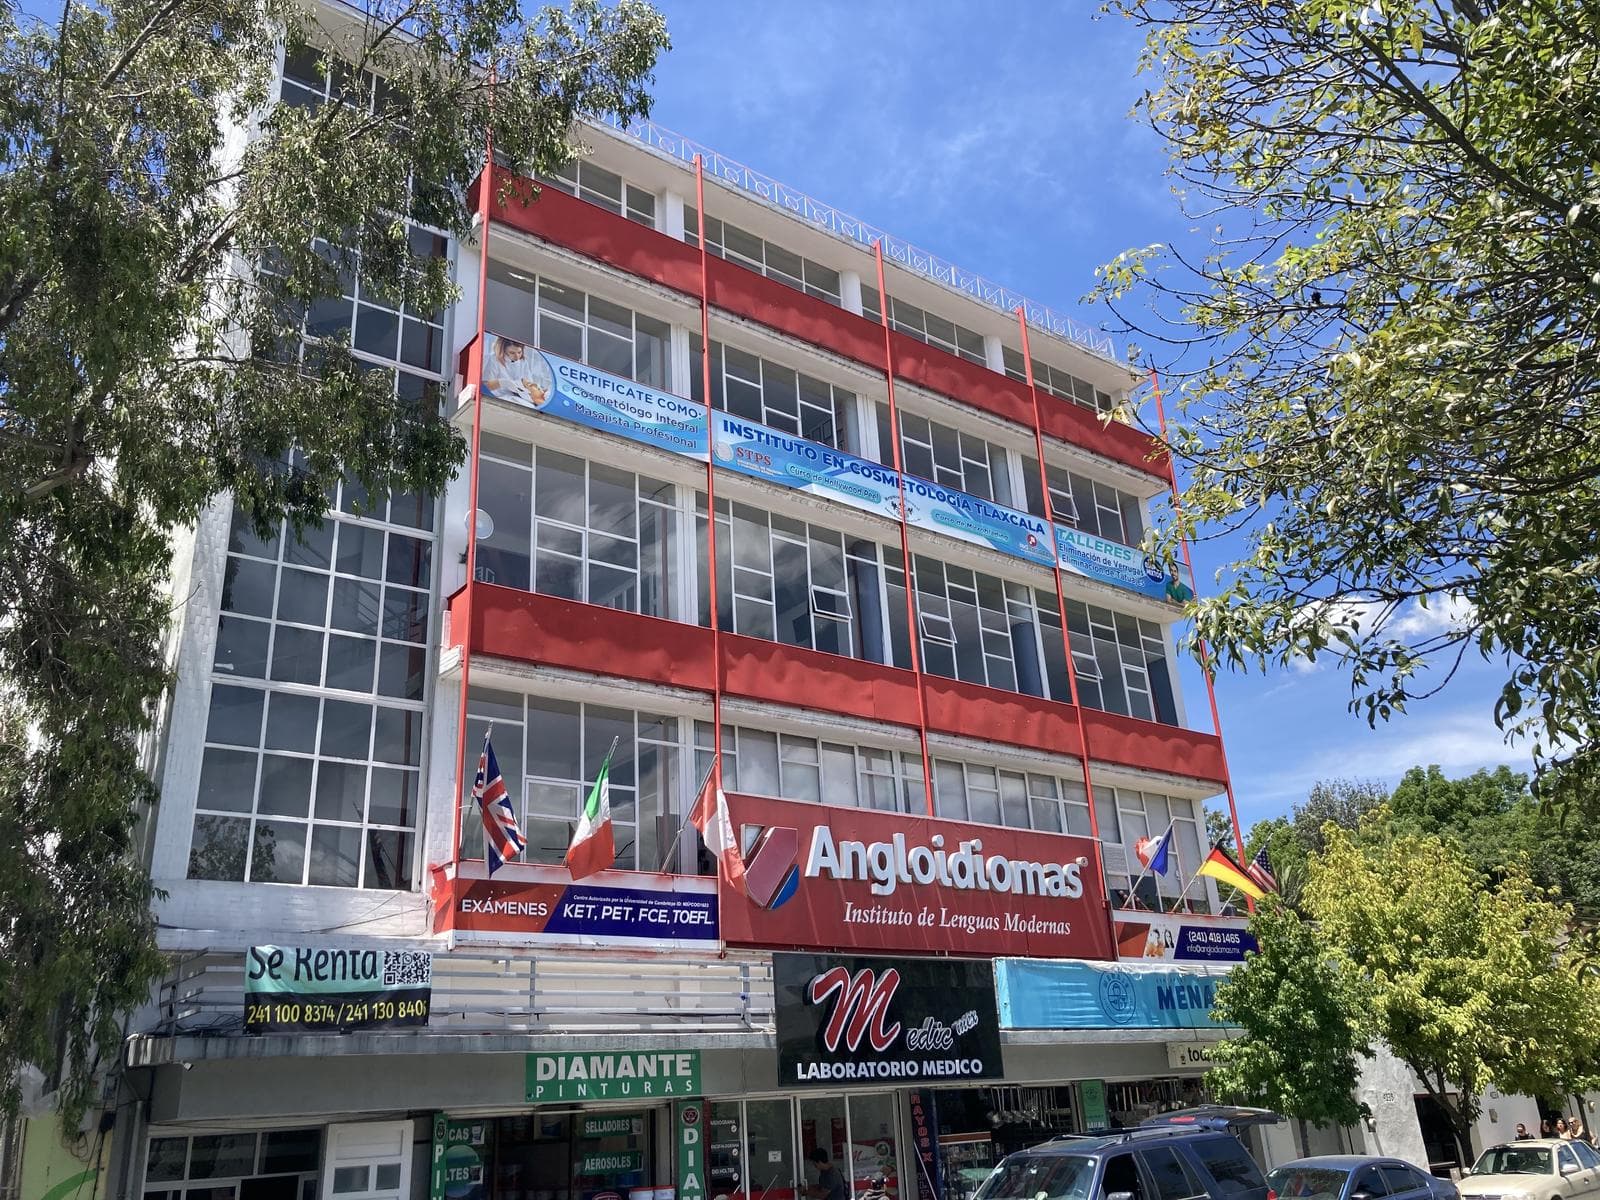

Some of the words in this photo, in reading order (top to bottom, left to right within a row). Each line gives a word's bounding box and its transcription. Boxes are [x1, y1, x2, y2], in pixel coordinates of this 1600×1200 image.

[559, 365, 653, 404] CERTIFICATE
[658, 398, 702, 420] COMO:
[572, 386, 652, 420] Cosmetólogo
[656, 411, 699, 433] Integral
[576, 403, 630, 429] Masajista
[634, 421, 697, 449] Profesional
[736, 446, 771, 466] STPS
[723, 419, 818, 460] INSTITUTO
[823, 455, 845, 470] EN
[850, 461, 971, 512] COSMETOLOGÍA
[974, 503, 1046, 535] TLAXCALA
[790, 465, 811, 479] Curso
[1056, 528, 1132, 561] TALLERES
[1059, 543, 1102, 563] Eliminación
[1103, 557, 1112, 567] de
[1062, 553, 1103, 575] Eliminación
[1106, 567, 1115, 577] de
[805, 825, 1084, 899] Angloidiomas
[461, 897, 548, 917] EXÁMENES
[563, 903, 598, 921] KET,
[601, 905, 635, 923] PET,
[638, 908, 670, 925] FCE,
[843, 901, 912, 926] Instituto
[917, 905, 936, 927] de
[939, 907, 1000, 934] Lenguas
[1003, 912, 1071, 936] Modernas
[1188, 931, 1208, 943] (241)
[1208, 931, 1221, 943] 418
[1222, 932, 1240, 944] 1465
[248, 946, 284, 980] Se
[294, 948, 378, 981] Renta
[247, 1005, 271, 1024] 241
[275, 1004, 300, 1023] 100
[372, 1002, 394, 1019] 130
[536, 1054, 693, 1081] DIAMANTE
[797, 1060, 919, 1080] LABORATORIO
[922, 1059, 983, 1076] MEDICO
[536, 1080, 693, 1099] PINTURAS
[585, 1119, 630, 1134] SELLADORES
[911, 1094, 930, 1147] RAYOS
[921, 1151, 933, 1162] X
[584, 1156, 631, 1171] AEROSOLES
